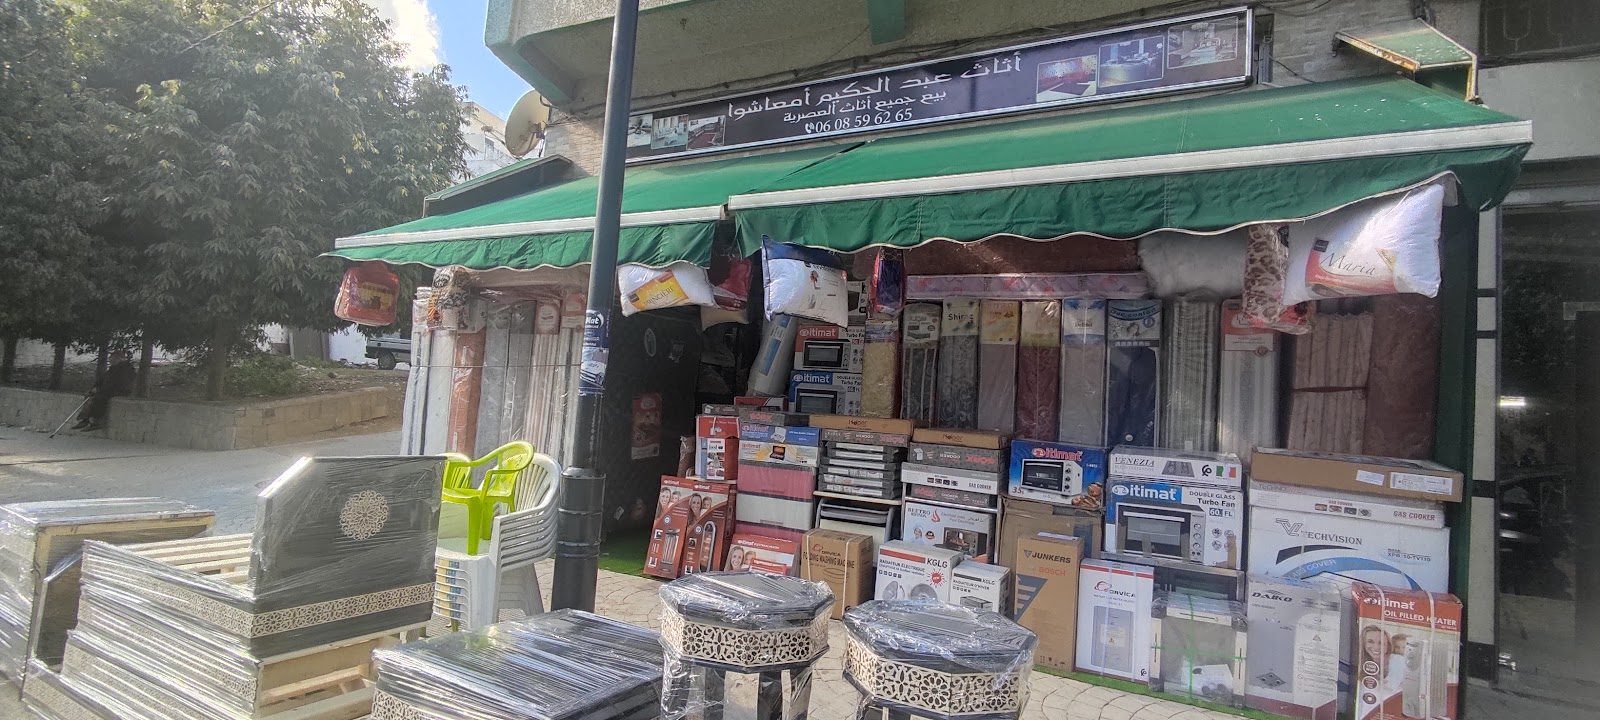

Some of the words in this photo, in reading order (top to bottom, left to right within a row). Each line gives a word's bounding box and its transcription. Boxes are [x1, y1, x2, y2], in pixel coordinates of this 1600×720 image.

[960, 51, 1021, 78] أثاث
[899, 73, 953, 89] عبد
[816, 76, 891, 106] الحكيم
[920, 91, 947, 105] بيع
[728, 87, 811, 121] أمعاشوا
[840, 95, 871, 112] أثاث
[875, 96, 917, 111] جميع
[783, 103, 836, 123] العصرية
[815, 120, 831, 133] 06
[834, 117, 850, 131] 08
[854, 114, 871, 128] 59
[874, 111, 891, 125] 62
[895, 108, 913, 121] 65
[1320, 252, 1376, 275] Maria
[809, 327, 837, 337] itimat
[803, 373, 830, 384] itimat
[1115, 457, 1155, 468] VENEZIA
[1130, 484, 1177, 500] itimat
[1189, 490, 1214, 498] DOUBLE
[1197, 498, 1219, 506] Turbo
[1221, 500, 1236, 508] Fan
[1408, 512, 1436, 521] COOKER
[1301, 530, 1363, 545] TECHVISION
[926, 558, 948, 568] KGLG
[1031, 552, 1071, 564] JUNKERS
[1039, 566, 1066, 576] BOSCH
[1384, 610, 1397, 618] OIL
[1399, 611, 1424, 621] FILLED
